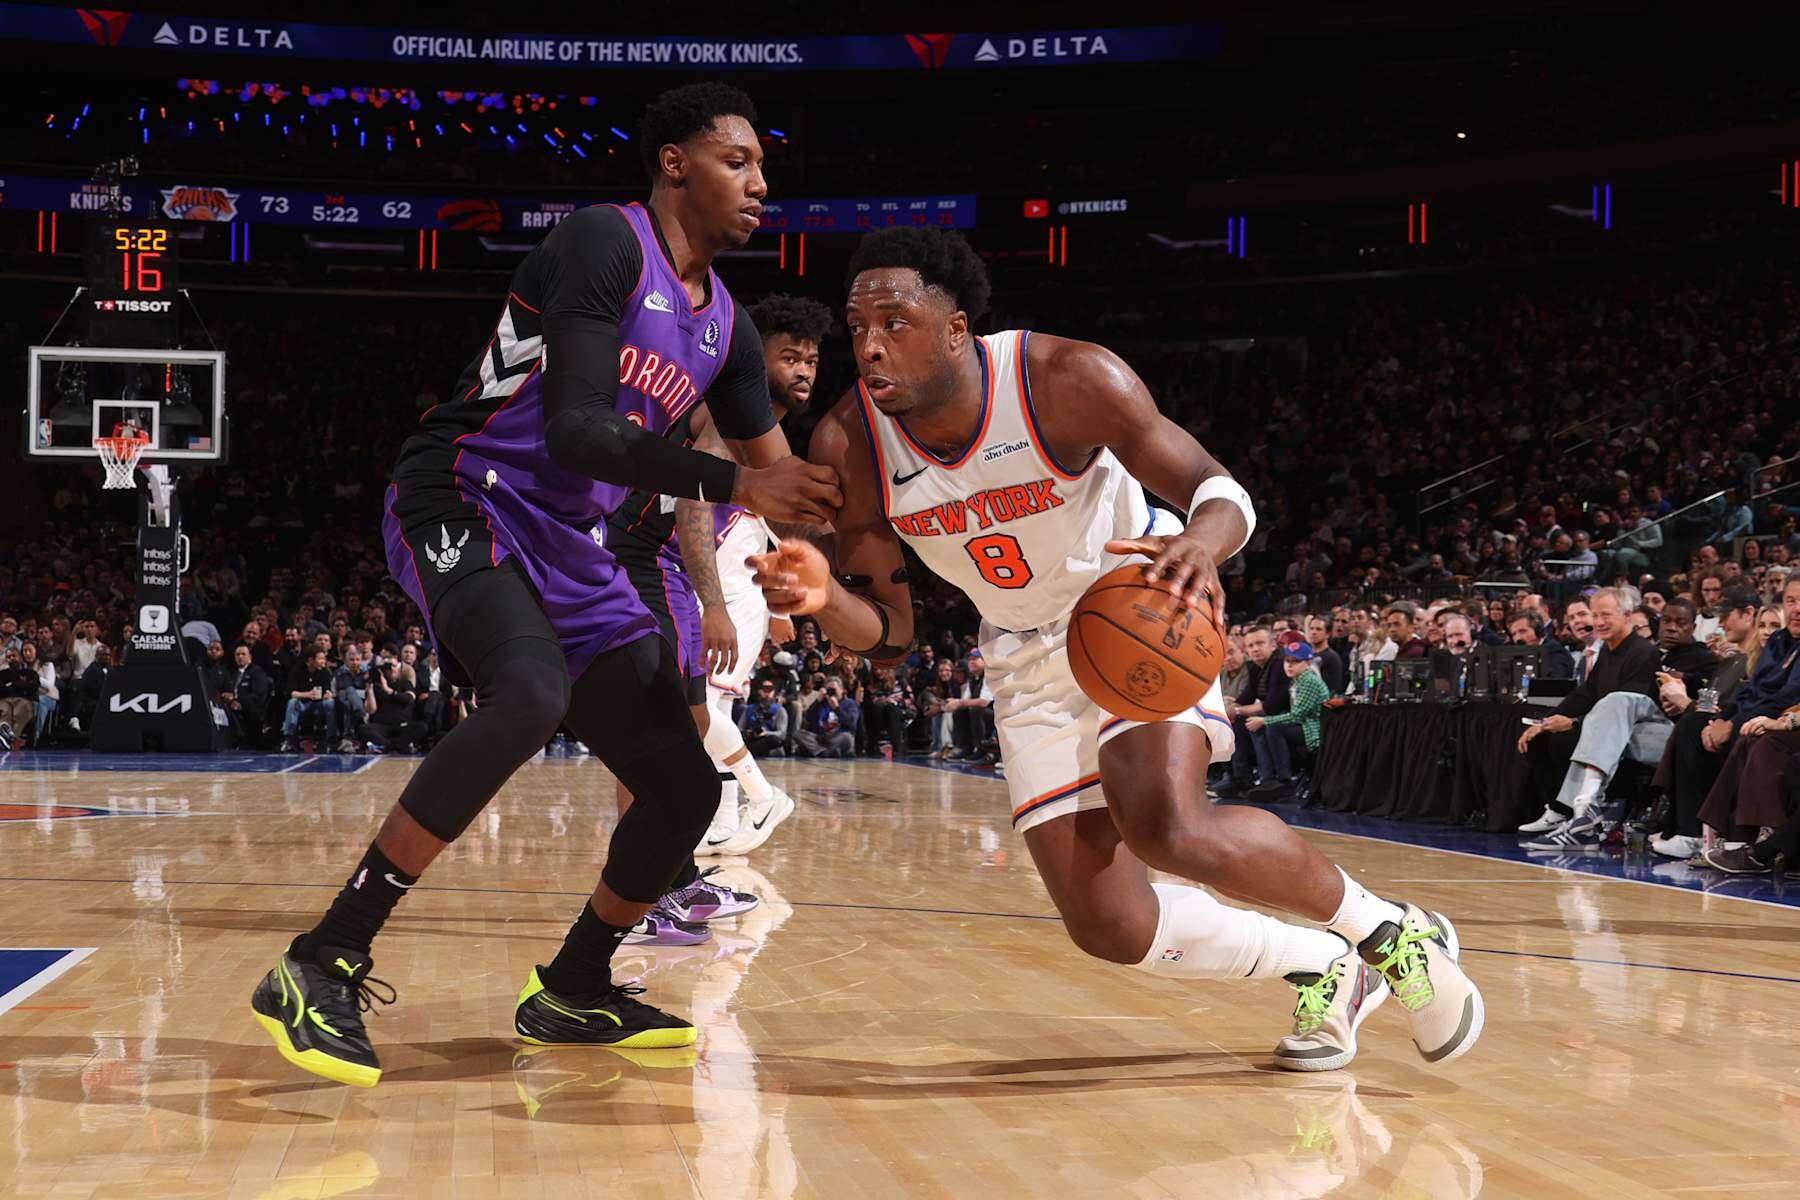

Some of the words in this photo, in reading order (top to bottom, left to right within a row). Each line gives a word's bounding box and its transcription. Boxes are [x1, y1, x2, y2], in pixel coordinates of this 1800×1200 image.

[188, 25, 294, 49] DELTA
[1008, 35, 1109, 59] DELTA
[392, 35, 477, 59] OFFICIAL
[480, 39, 555, 61] AIRLINE
[558, 41, 584, 62] OF
[587, 41, 624, 62] THE
[627, 42, 673, 62] NEW
[676, 43, 728, 63] YORK
[731, 43, 803, 64] KNICKS.
[260, 195, 290, 214] 73
[312, 205, 360, 223] 5:22
[382, 201, 412, 219] 62
[856, 203, 871, 211] TO
[522, 211, 570, 229] RAPT
[115, 228, 168, 251] 5:22
[123, 252, 162, 291] 16
[115, 300, 172, 313] TISSOT
[650, 290, 669, 307] NIKE
[984, 450, 1003, 461] abu
[1002, 438, 1030, 455] dhabi
[890, 499, 968, 537] NEW
[966, 477, 1066, 531] YORK
[963, 532, 1034, 590] 8
[131, 635, 176, 645] CAESARS
